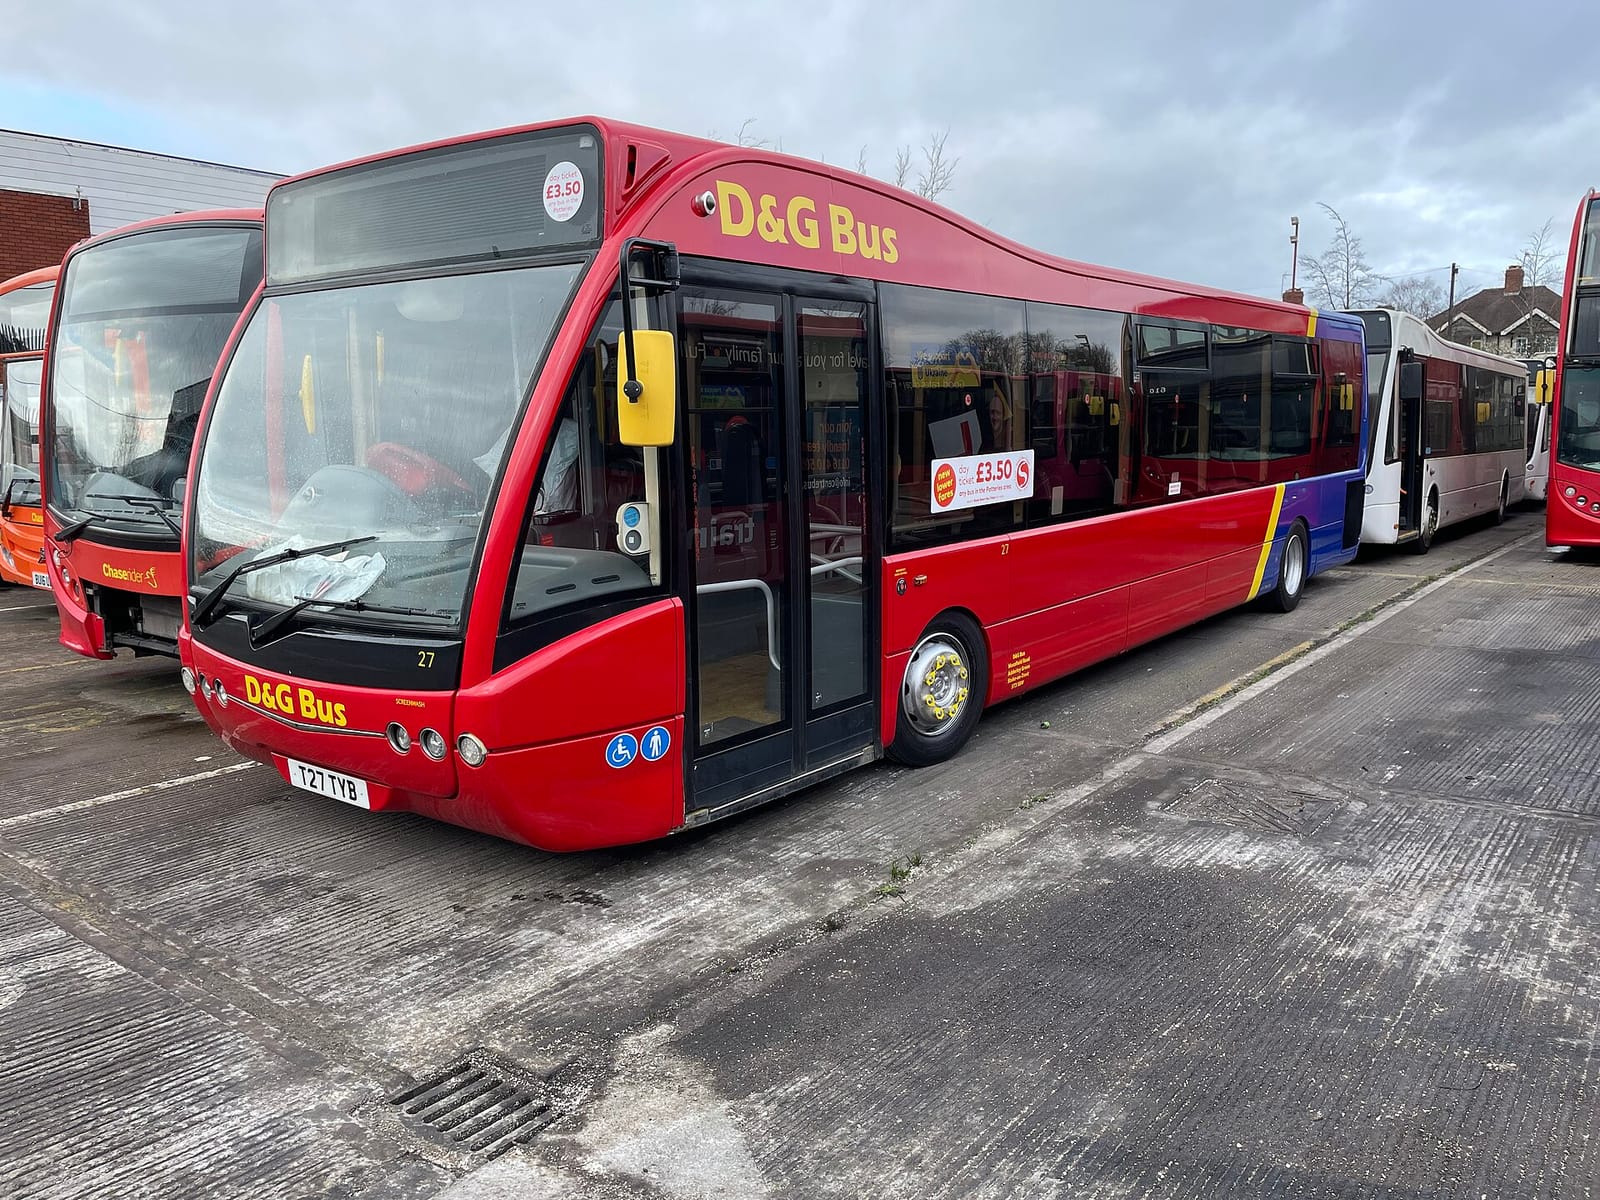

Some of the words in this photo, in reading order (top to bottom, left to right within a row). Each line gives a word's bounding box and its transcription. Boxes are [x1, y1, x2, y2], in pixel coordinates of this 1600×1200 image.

[546, 181, 581, 199] £3.50
[716, 180, 820, 249] D&G
[828, 203, 899, 264] Bus
[938, 469, 951, 480] new
[959, 465, 969, 474] day
[976, 459, 1012, 483] £3.50
[936, 479, 954, 493] lower
[958, 478, 974, 486] ticket
[938, 490, 954, 502] fares
[1001, 544, 1009, 556] 27
[102, 563, 144, 583] Chaserider
[418, 651, 435, 668] 27
[244, 674, 294, 714] D&G
[298, 688, 347, 726] Bus
[298, 765, 324, 791] T27
[328, 776, 357, 801] TYB
